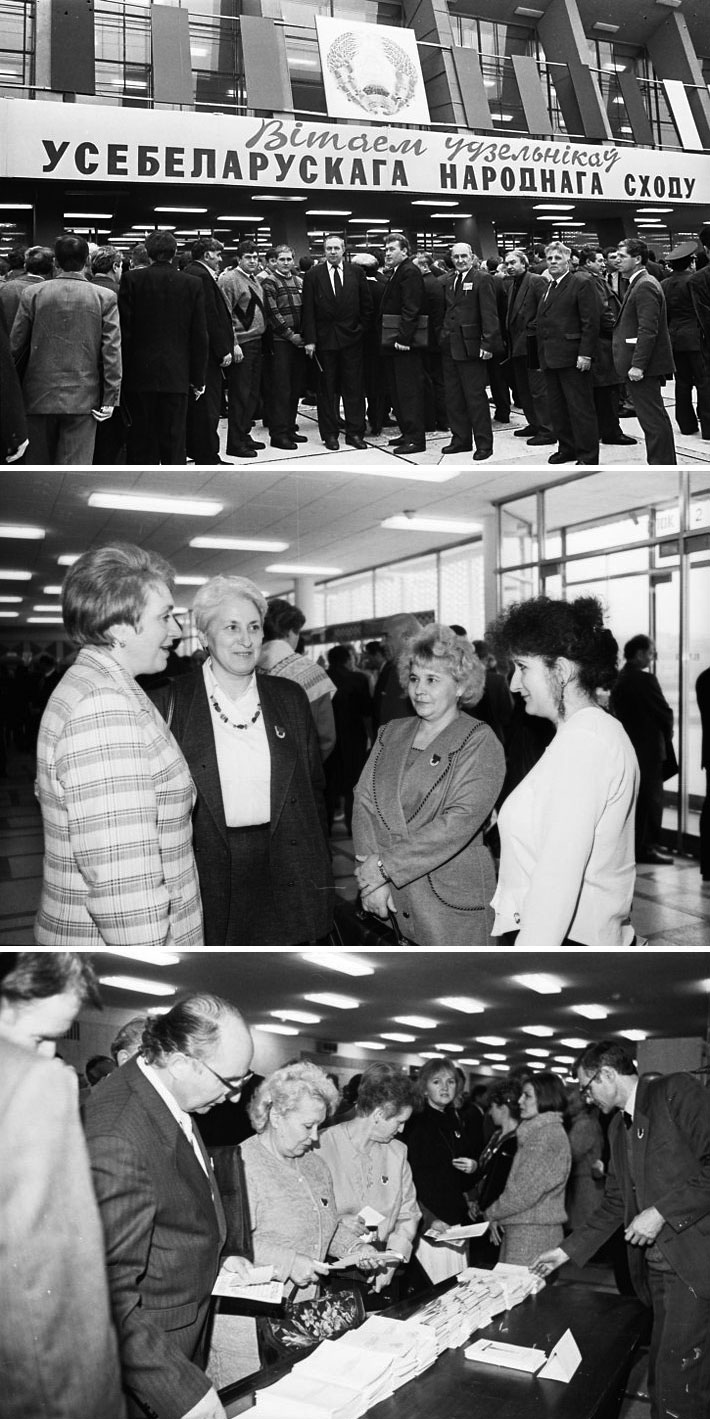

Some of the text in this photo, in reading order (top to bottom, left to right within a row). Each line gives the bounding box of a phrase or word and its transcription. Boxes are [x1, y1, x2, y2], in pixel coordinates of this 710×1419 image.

[41, 139, 696, 199] УСЕБЕЛАРУСКАГА НАРОДНАГА СХОДУ
[245, 118, 622, 173] Вітаем удзельнікаў
